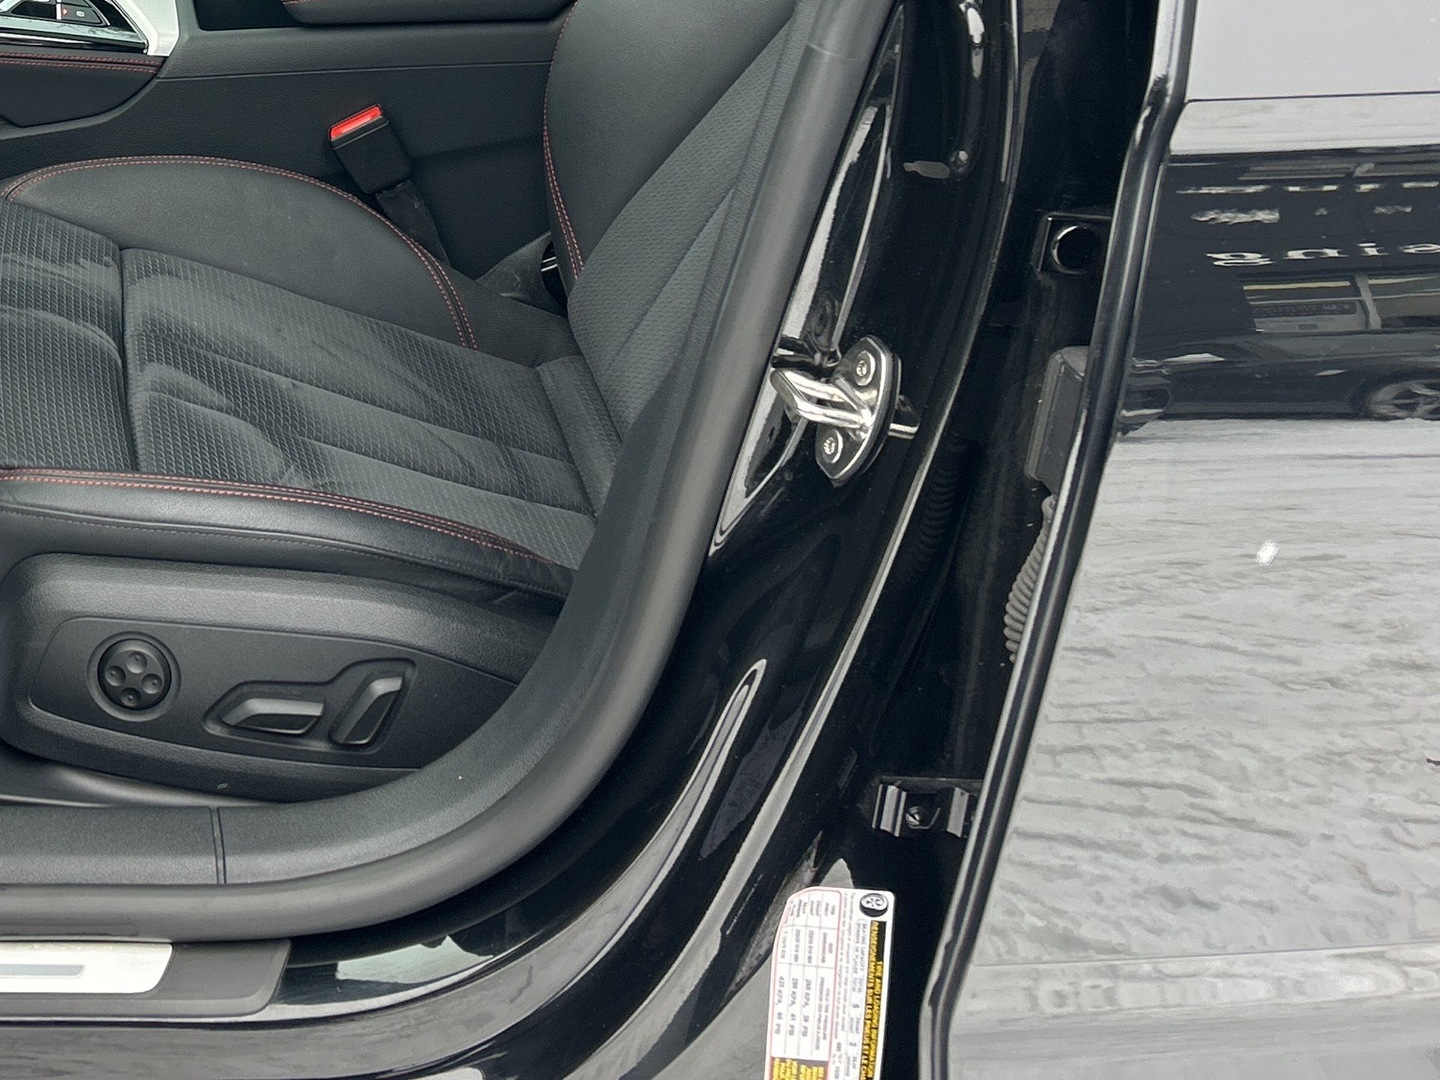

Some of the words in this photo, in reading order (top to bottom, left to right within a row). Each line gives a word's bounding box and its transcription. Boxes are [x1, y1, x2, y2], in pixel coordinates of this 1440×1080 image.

[873, 978, 882, 994] AND
[865, 1005, 873, 1019] LES
[870, 994, 881, 1028] LOADING
[863, 1020, 872, 1043] PNEUS
[867, 1028, 879, 1077] INFORMATION
